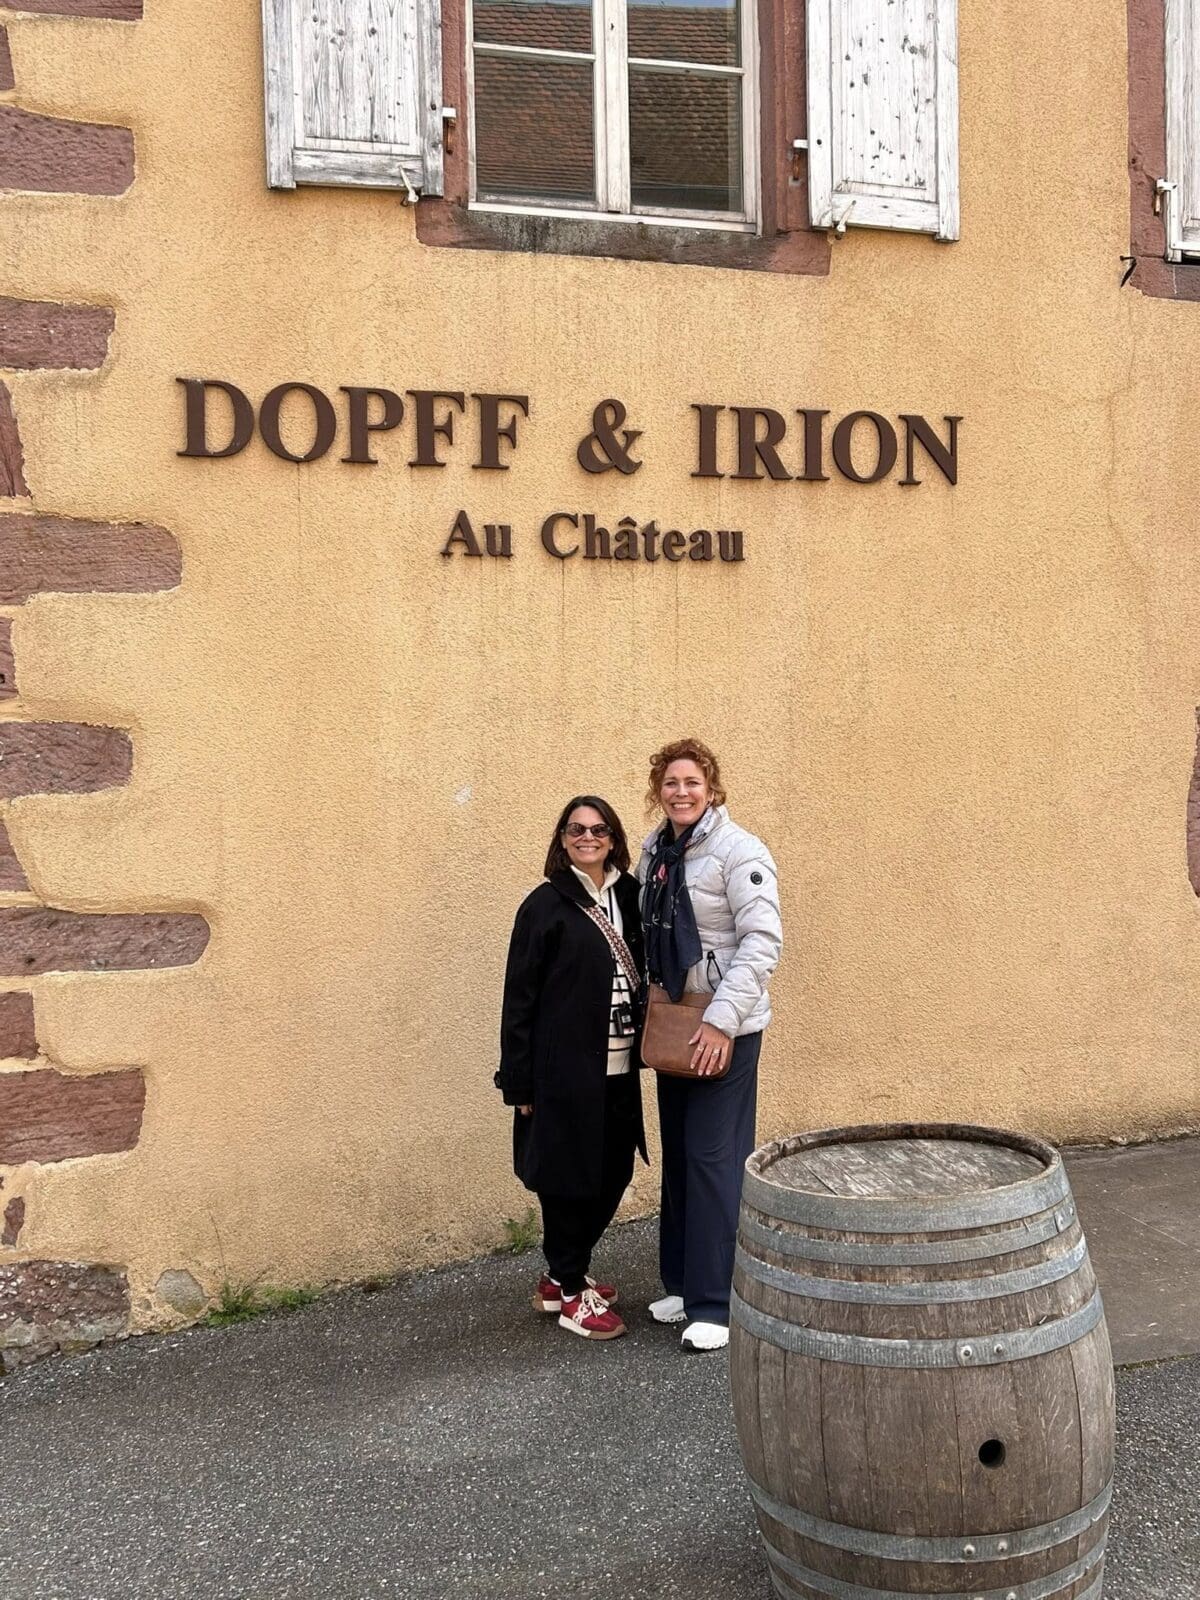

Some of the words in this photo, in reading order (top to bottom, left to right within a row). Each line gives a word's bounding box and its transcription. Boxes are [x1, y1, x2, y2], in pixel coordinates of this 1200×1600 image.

[176, 378, 528, 471] DOPFF
[577, 399, 642, 475] &
[691, 404, 963, 486] IRION
[440, 510, 512, 558] Au
[541, 513, 745, 562] Château
